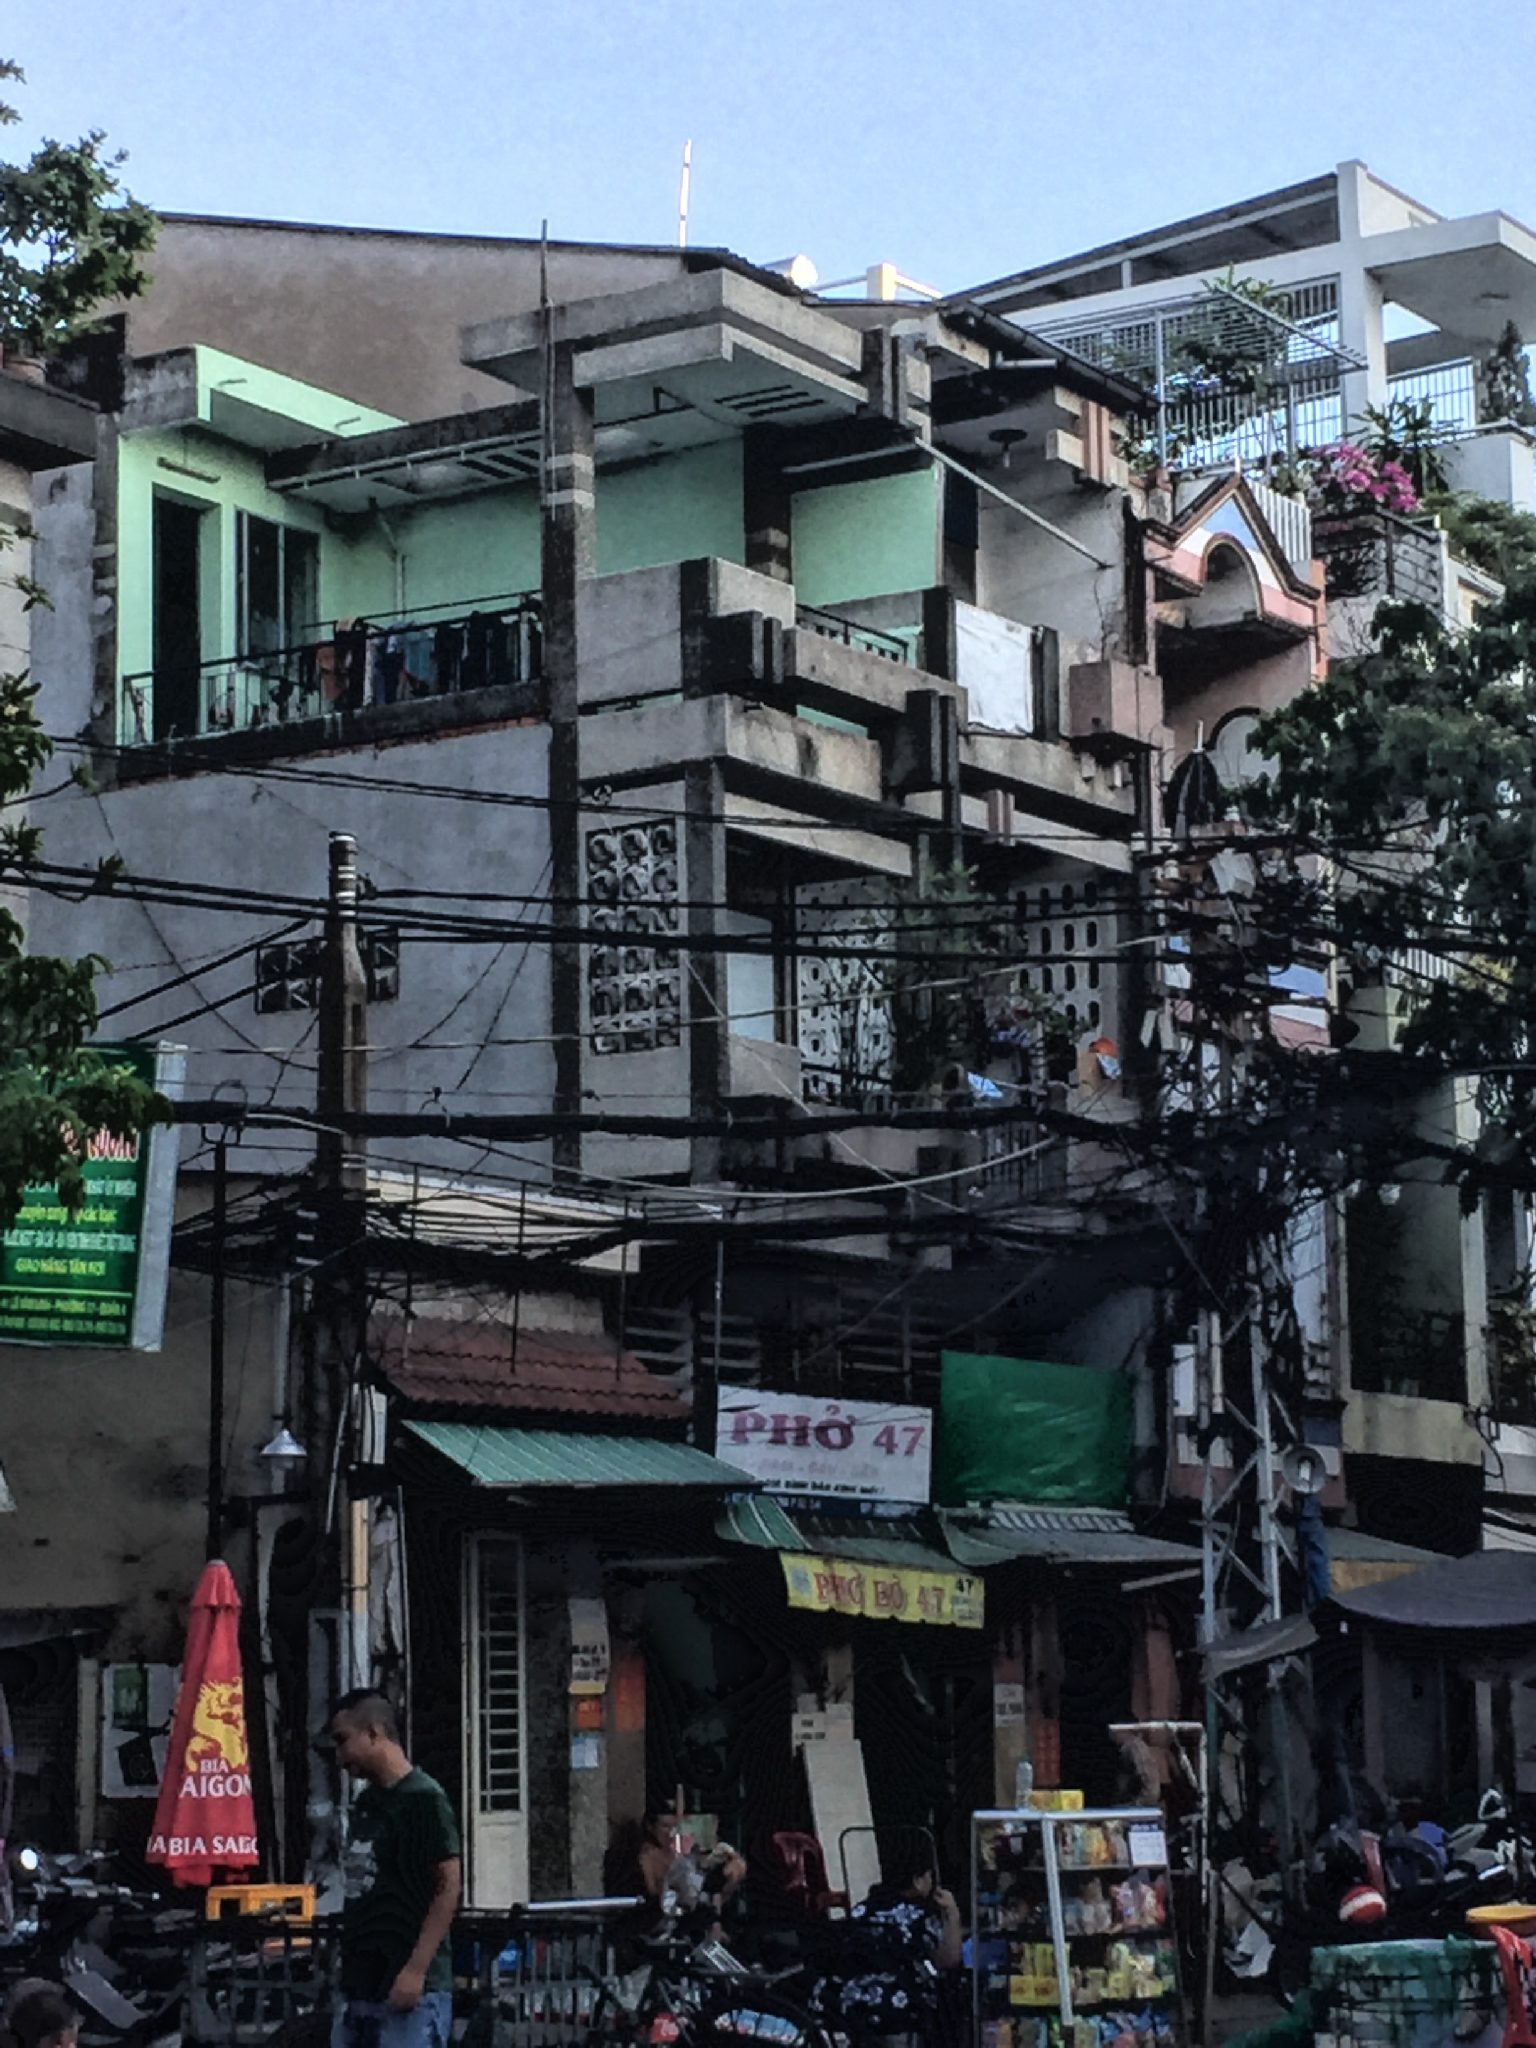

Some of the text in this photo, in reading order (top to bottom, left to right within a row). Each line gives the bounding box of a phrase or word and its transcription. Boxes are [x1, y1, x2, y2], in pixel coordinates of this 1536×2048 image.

[730, 1404, 926, 1457] PHỞ 47
[916, 1585, 946, 1618] 47
[200, 1758, 229, 1774] BIA
[168, 1836, 208, 1856] BIA
